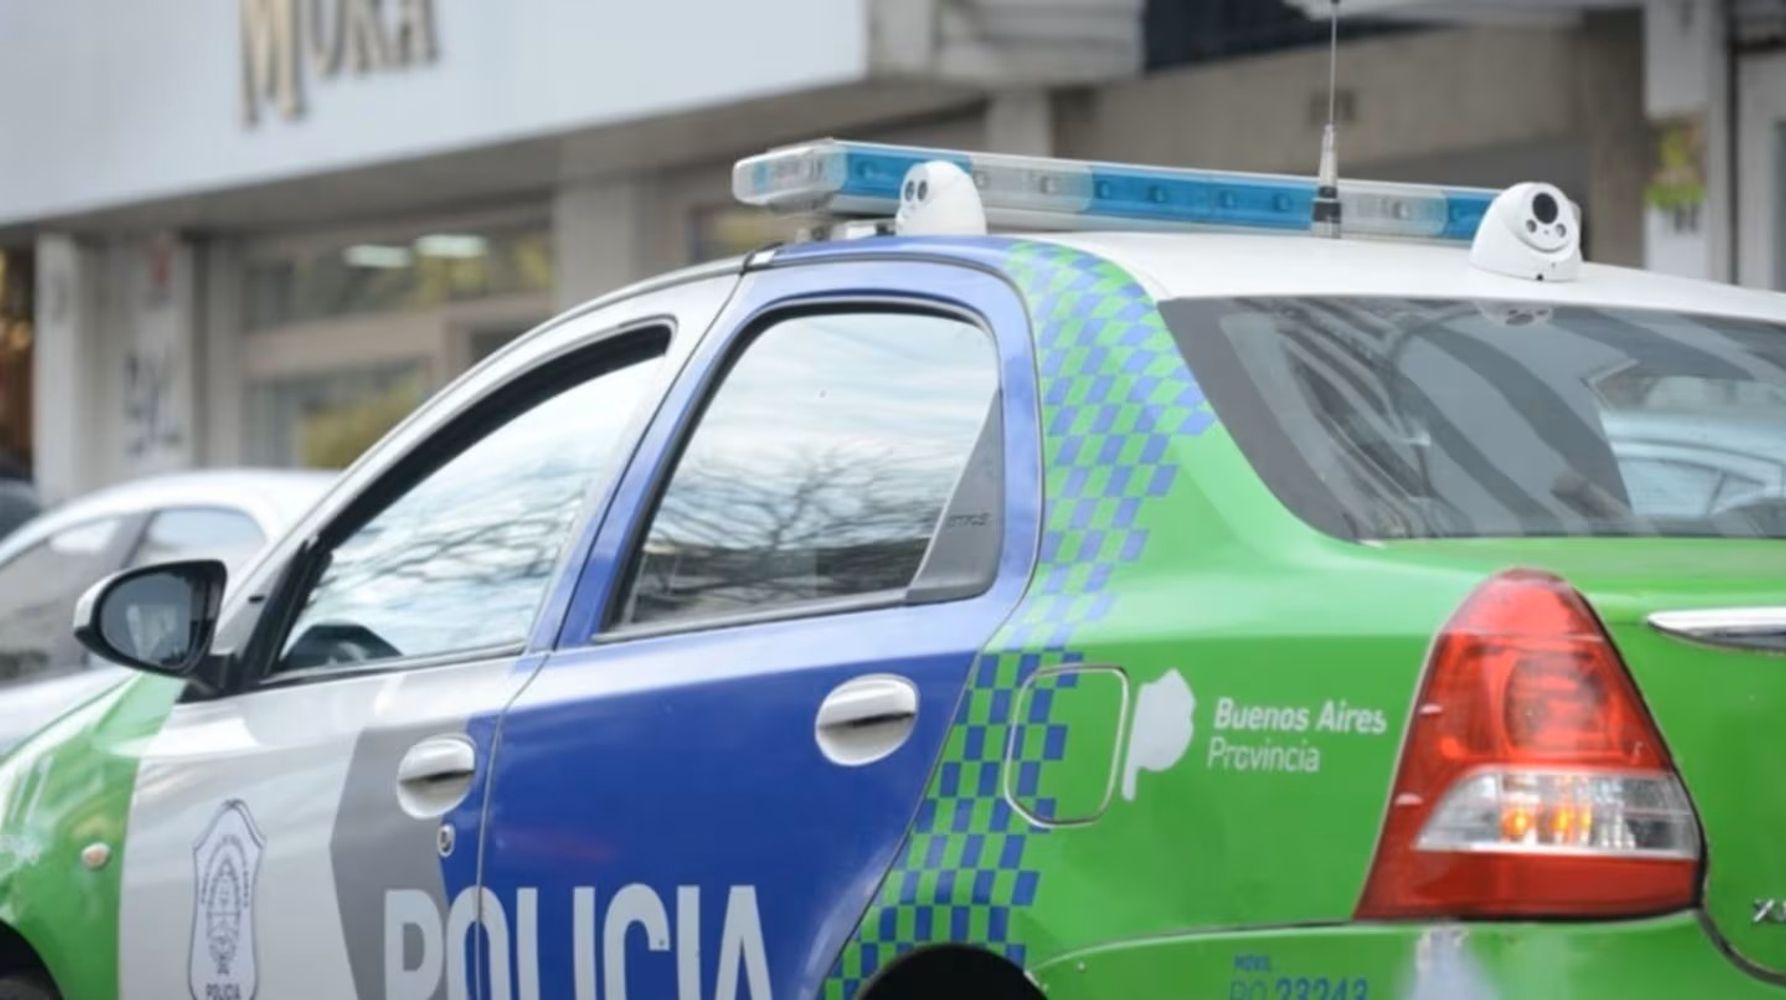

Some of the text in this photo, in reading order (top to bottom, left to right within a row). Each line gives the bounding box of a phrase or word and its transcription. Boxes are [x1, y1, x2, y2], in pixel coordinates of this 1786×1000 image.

[1214, 696, 1387, 735] Buenos Aires
[1207, 735, 1321, 773] Provincia
[384, 883, 773, 1000] POLICIA
